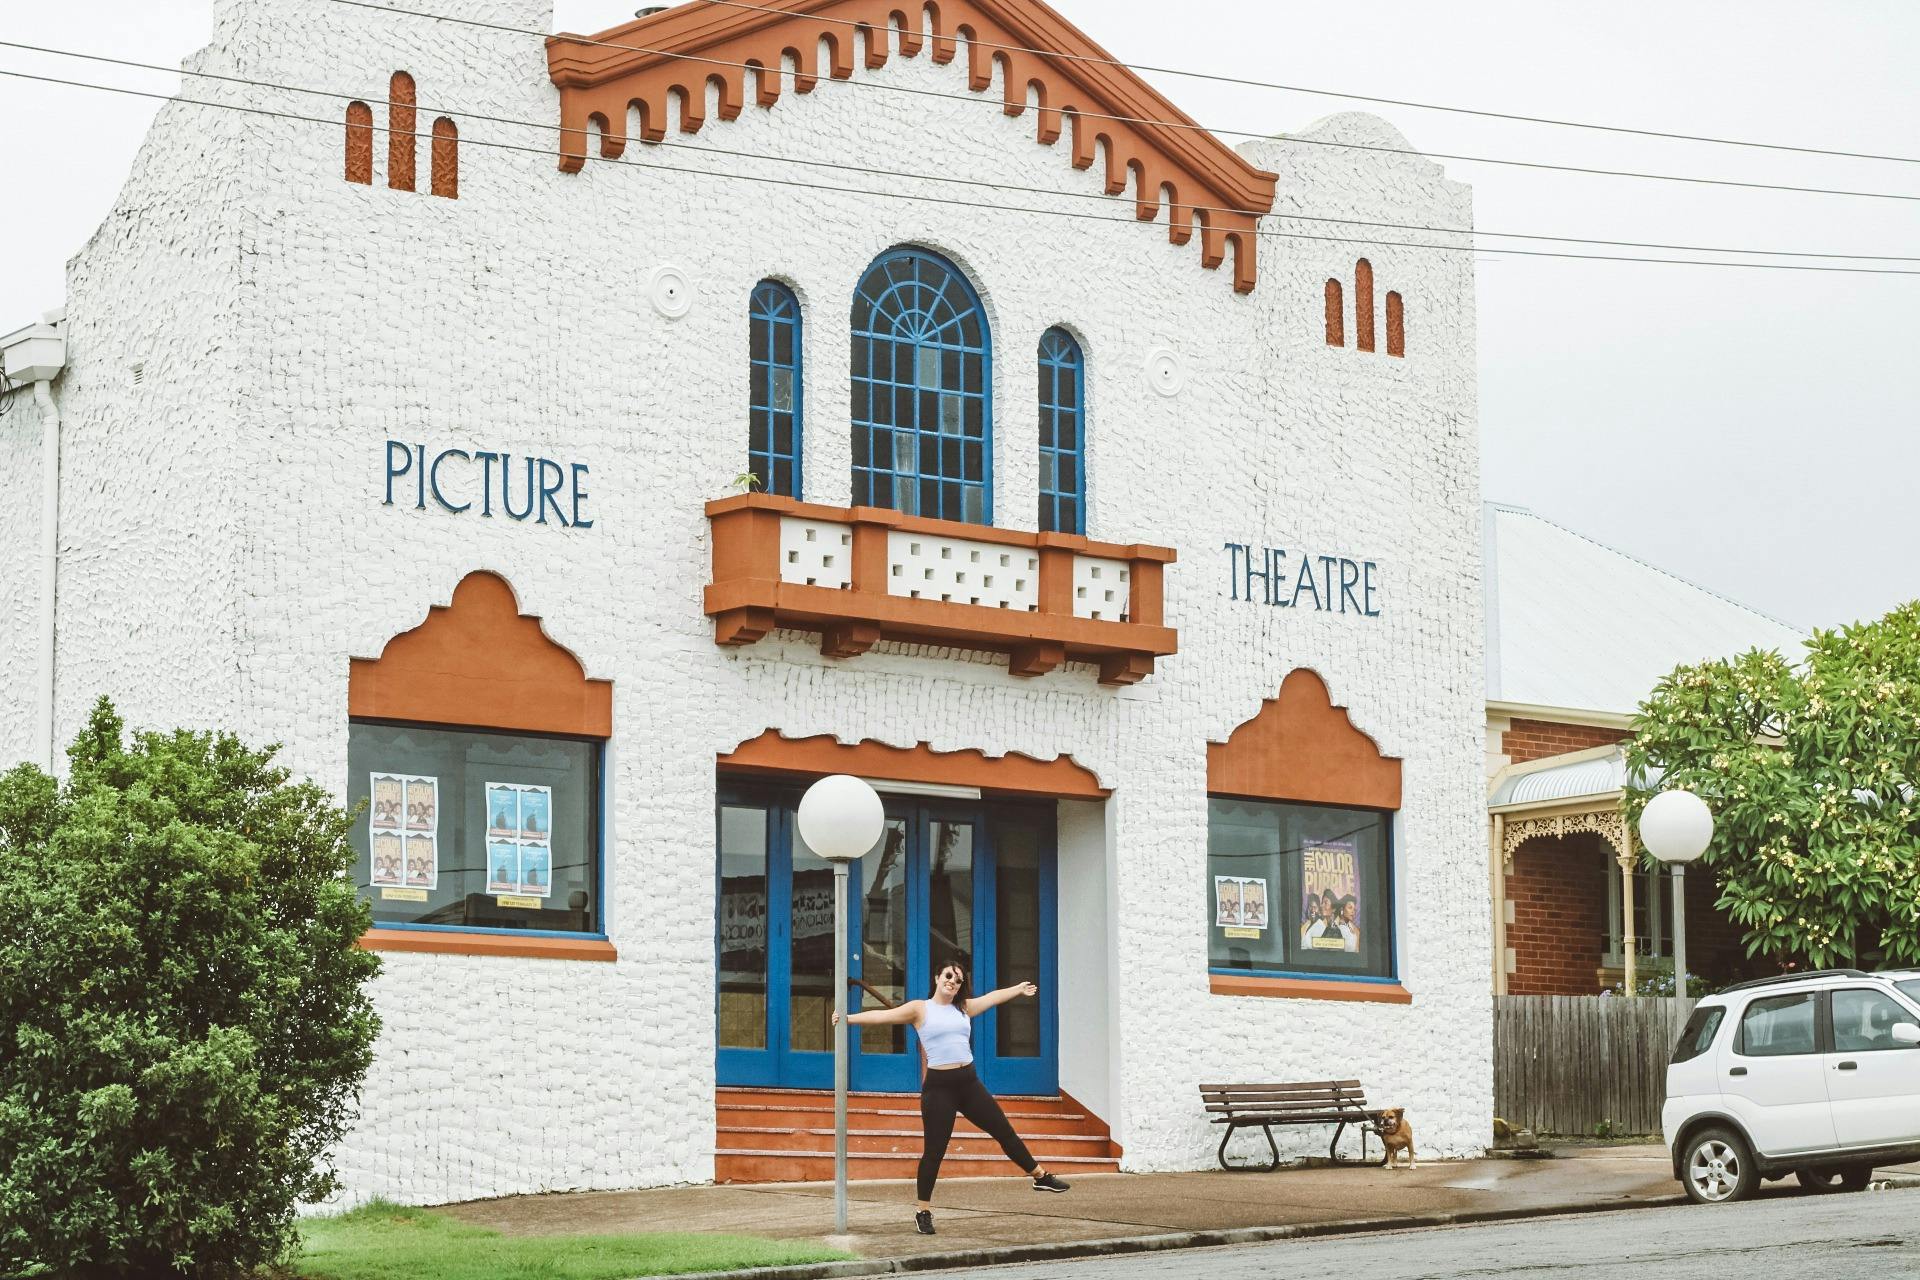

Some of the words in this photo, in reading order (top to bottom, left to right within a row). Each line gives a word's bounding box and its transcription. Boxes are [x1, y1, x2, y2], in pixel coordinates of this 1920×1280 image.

[381, 440, 594, 529] PICTURE
[1223, 542, 1381, 617] THEATRE
[1304, 851, 1316, 871] THE
[1314, 851, 1354, 876] COLOR
